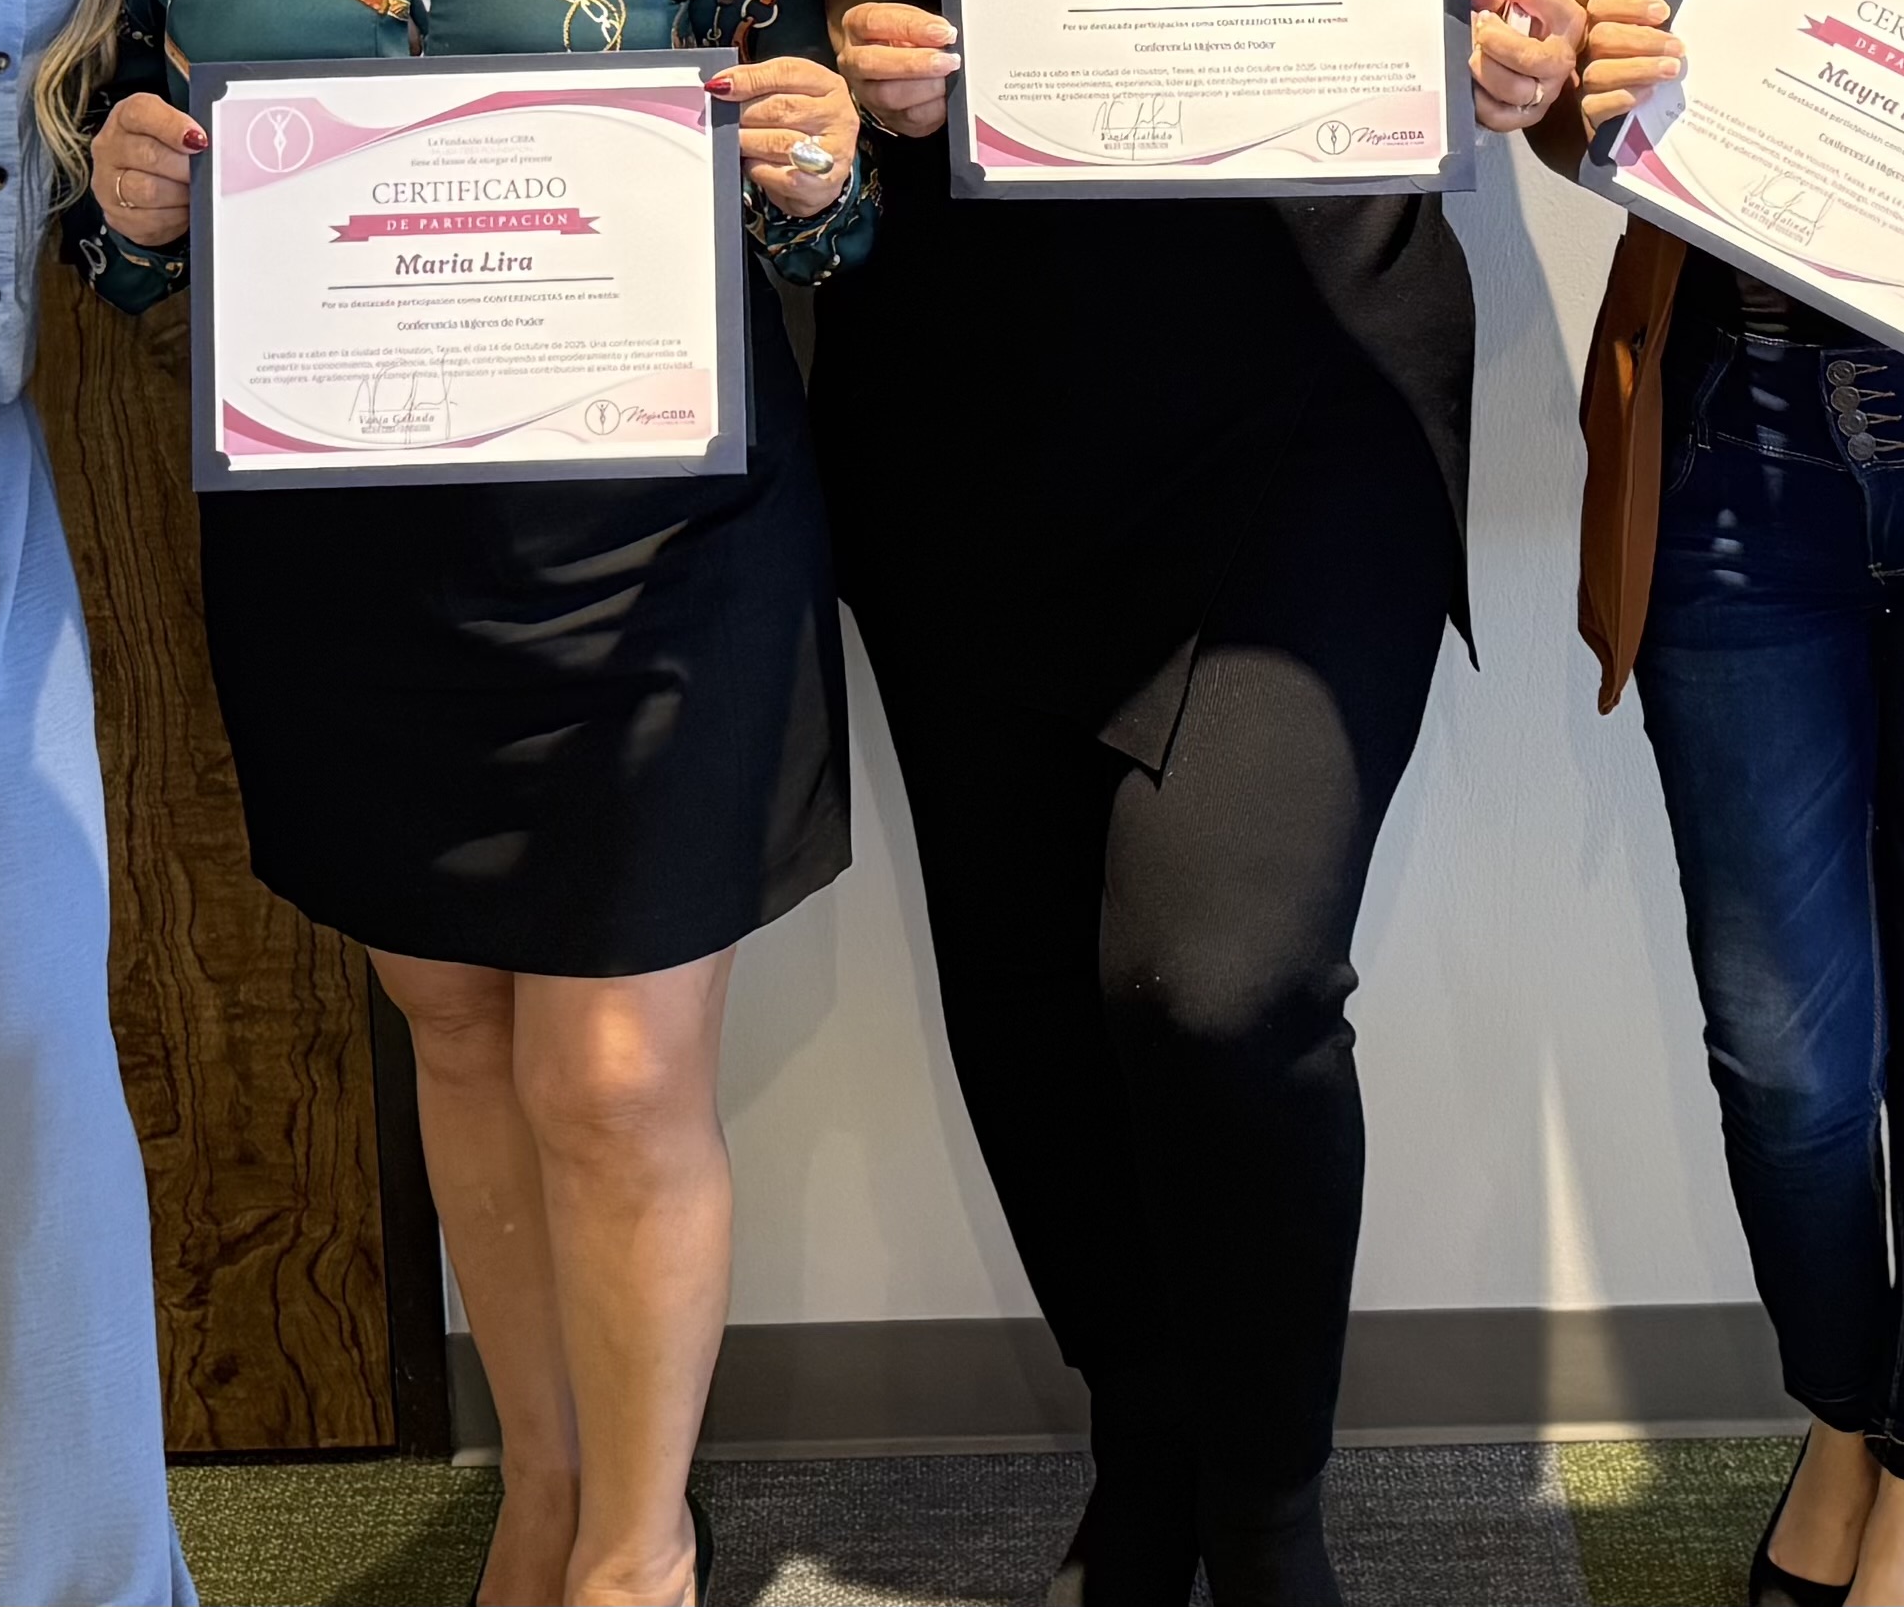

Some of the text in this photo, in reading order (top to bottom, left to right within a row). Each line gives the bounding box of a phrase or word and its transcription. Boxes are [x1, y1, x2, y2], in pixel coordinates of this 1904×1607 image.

[1853, 36, 1879, 56] DE
[1814, 59, 1902, 120] Mayra
[371, 175, 567, 205] CERTIFICADO
[385, 219, 408, 231] DE
[394, 249, 533, 275] Maria Lira
[321, 300, 336, 309] Por
